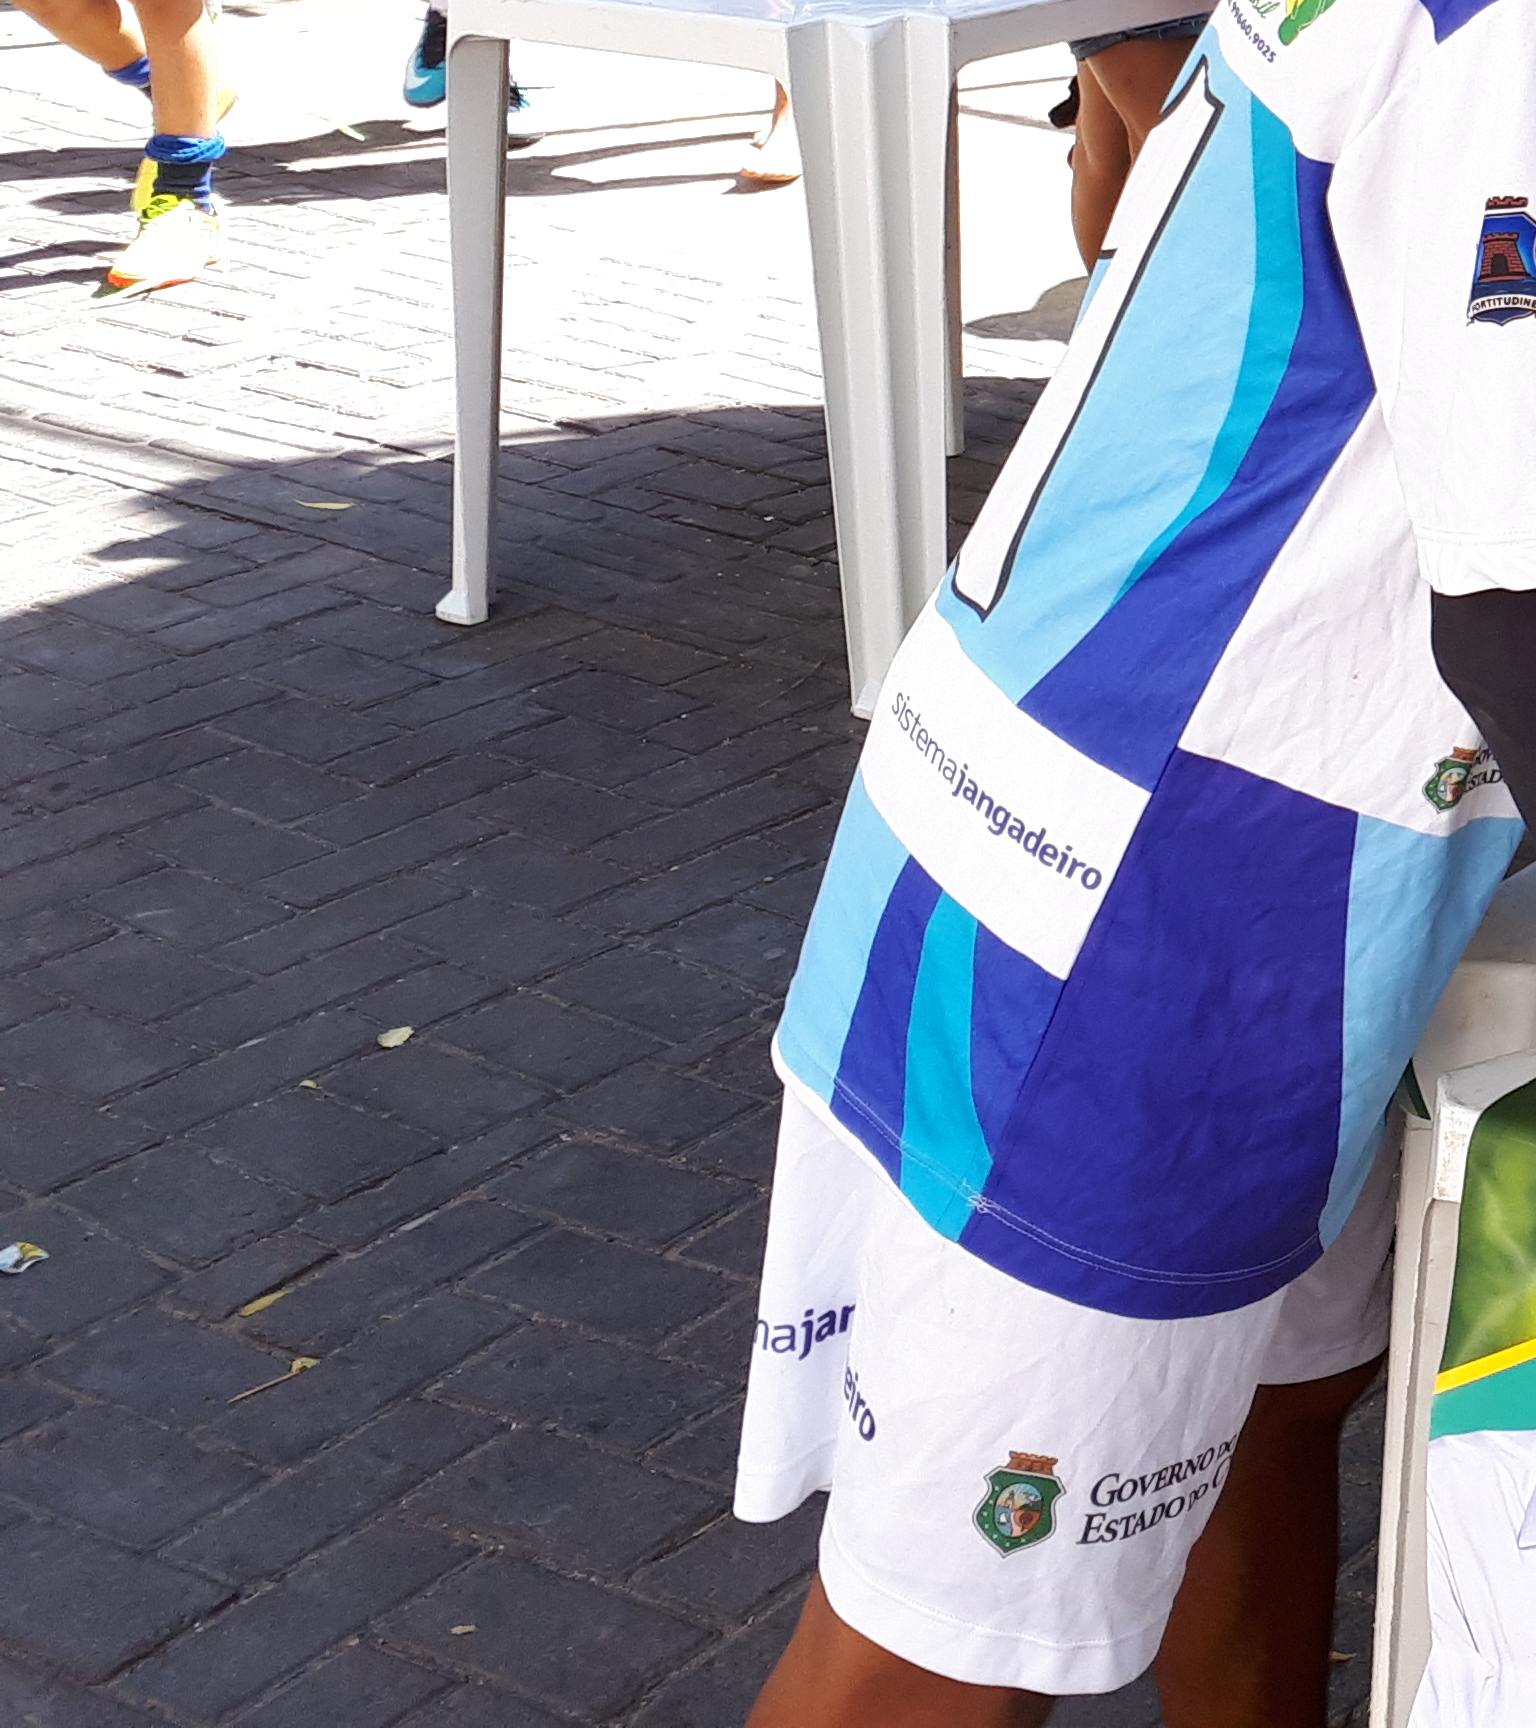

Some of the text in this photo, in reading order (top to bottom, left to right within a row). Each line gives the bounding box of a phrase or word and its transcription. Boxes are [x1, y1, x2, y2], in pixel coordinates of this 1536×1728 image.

[890, 690, 1105, 892] sistemajangadeiro
[1089, 1448, 1216, 1508] GOVERNO
[1074, 1482, 1208, 1546] ESTADO DO
